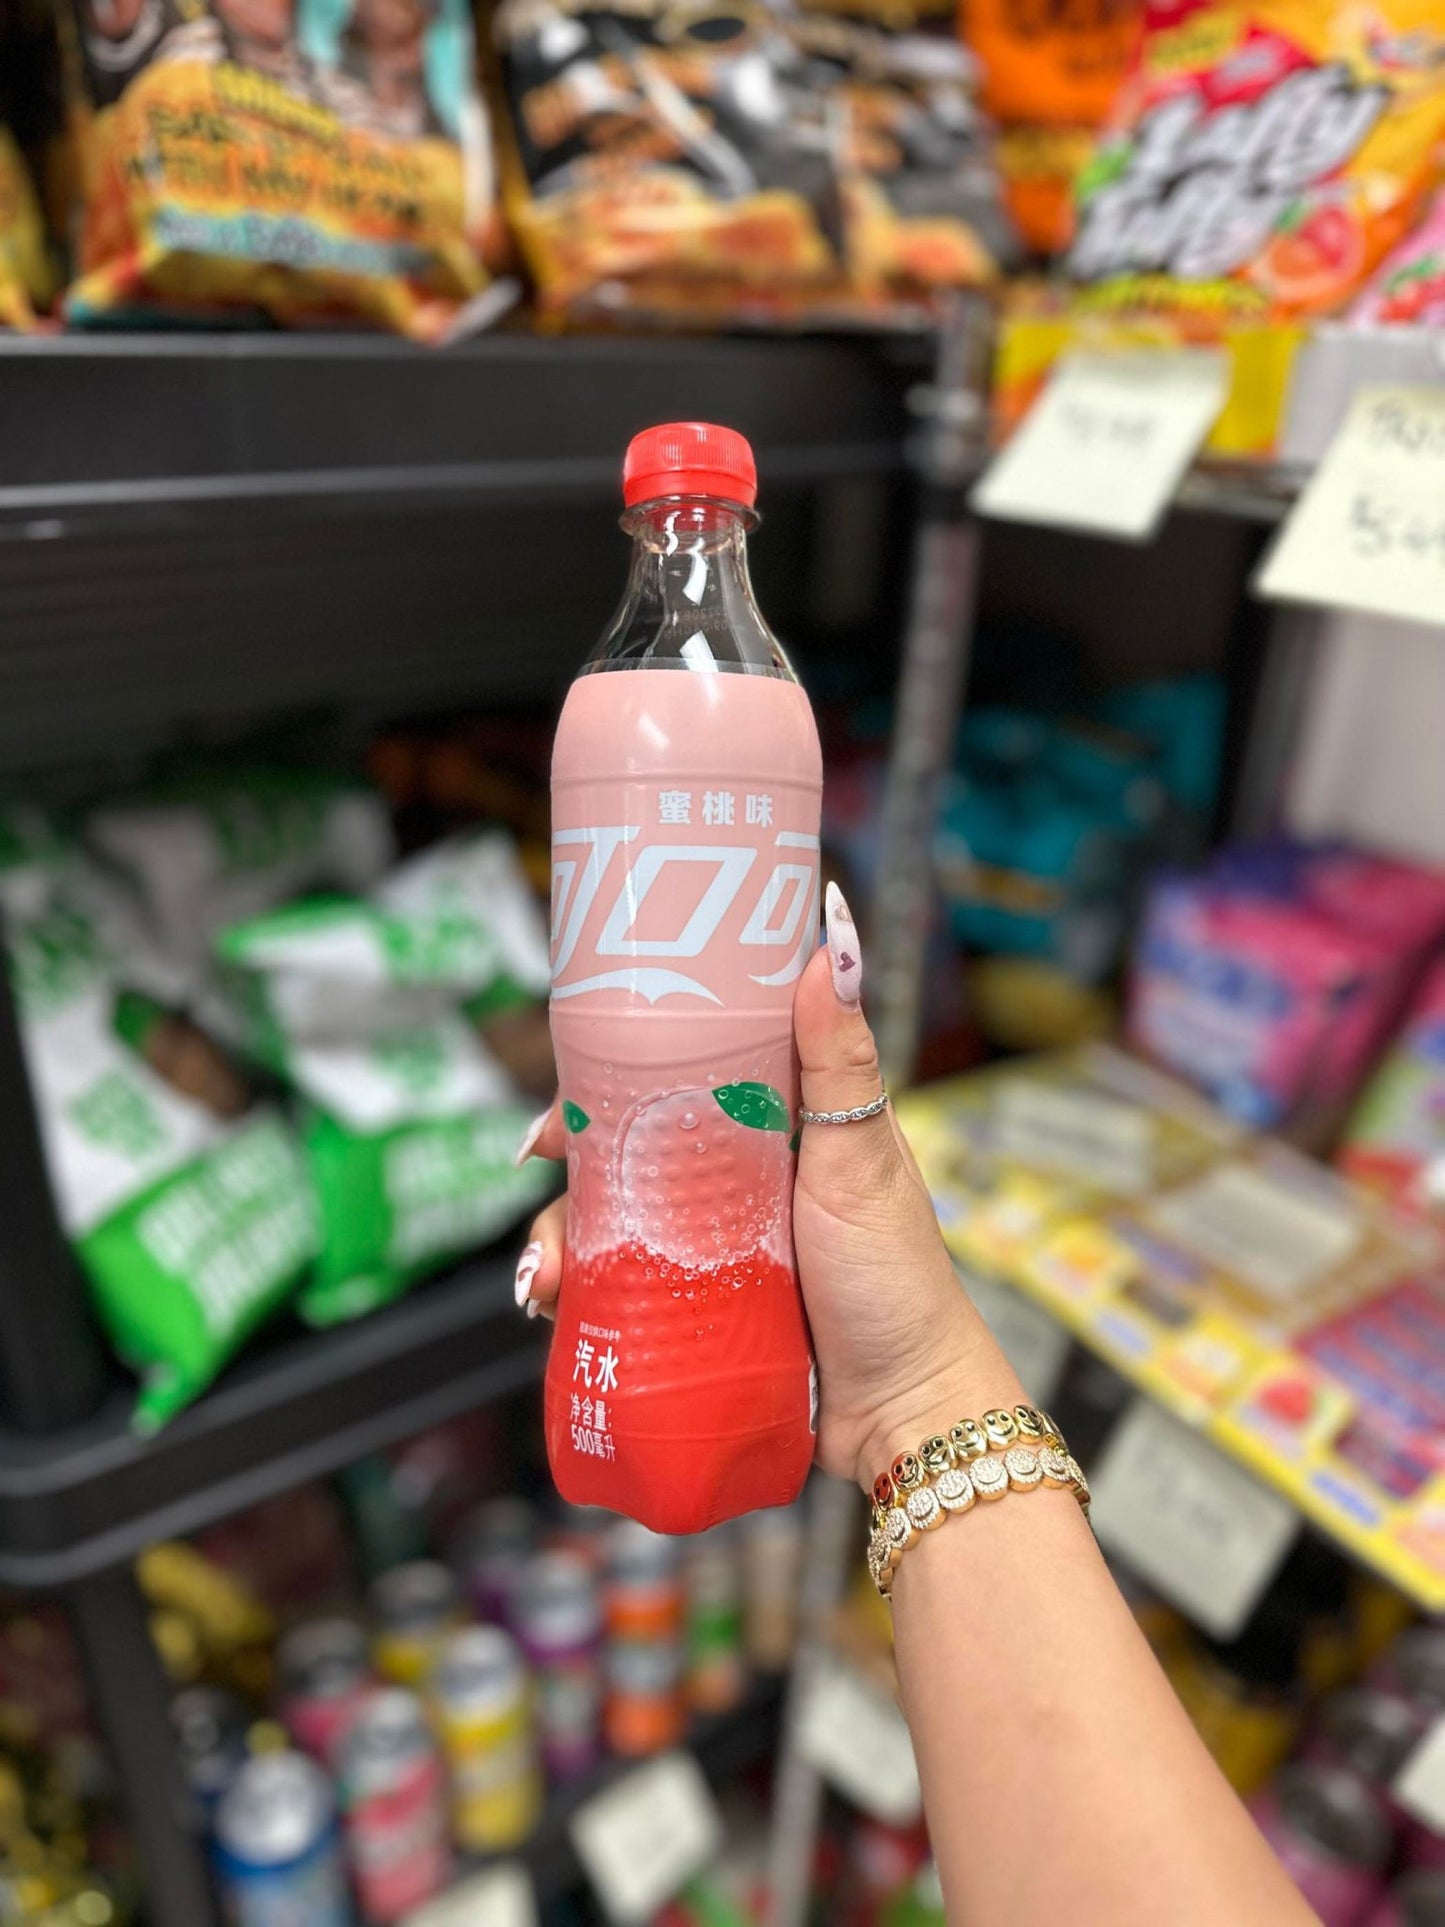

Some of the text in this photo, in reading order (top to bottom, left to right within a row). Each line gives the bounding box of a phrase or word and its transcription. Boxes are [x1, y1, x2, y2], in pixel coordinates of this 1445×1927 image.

[659, 790, 774, 828] 蜜桃味
[573, 1338, 619, 1393] 汽水
[571, 1423, 616, 1463] 500毫升
